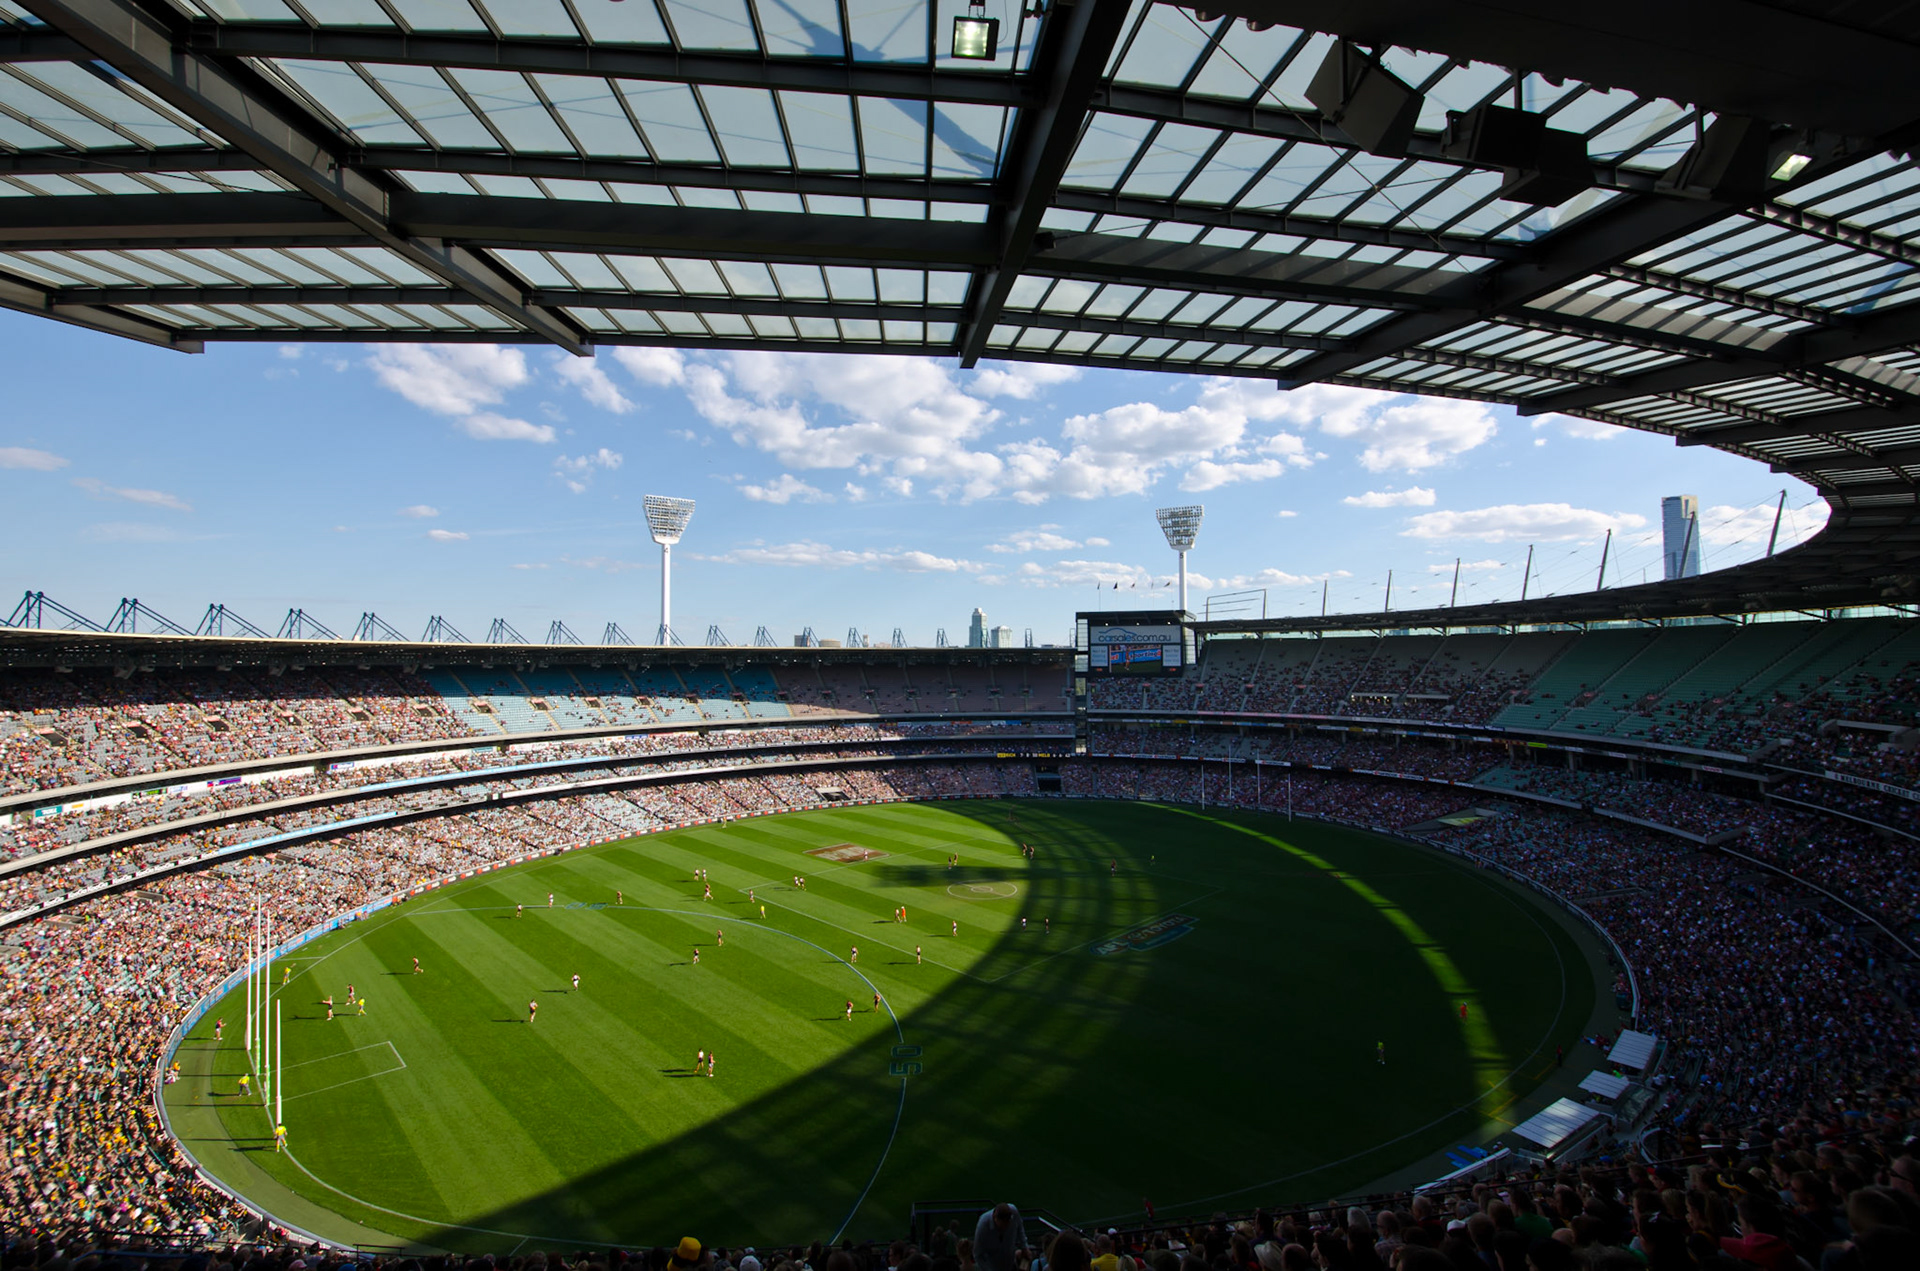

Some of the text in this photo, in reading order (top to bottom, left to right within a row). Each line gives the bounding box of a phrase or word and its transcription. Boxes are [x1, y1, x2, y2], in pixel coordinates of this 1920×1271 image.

[1098, 633, 1171, 642] carsales.com.au
[1840, 775, 1880, 790] MELBOURNE
[1883, 785, 1910, 798] CRICKET
[1096, 940, 1130, 955] AFL
[889, 1045, 923, 1076] 50
